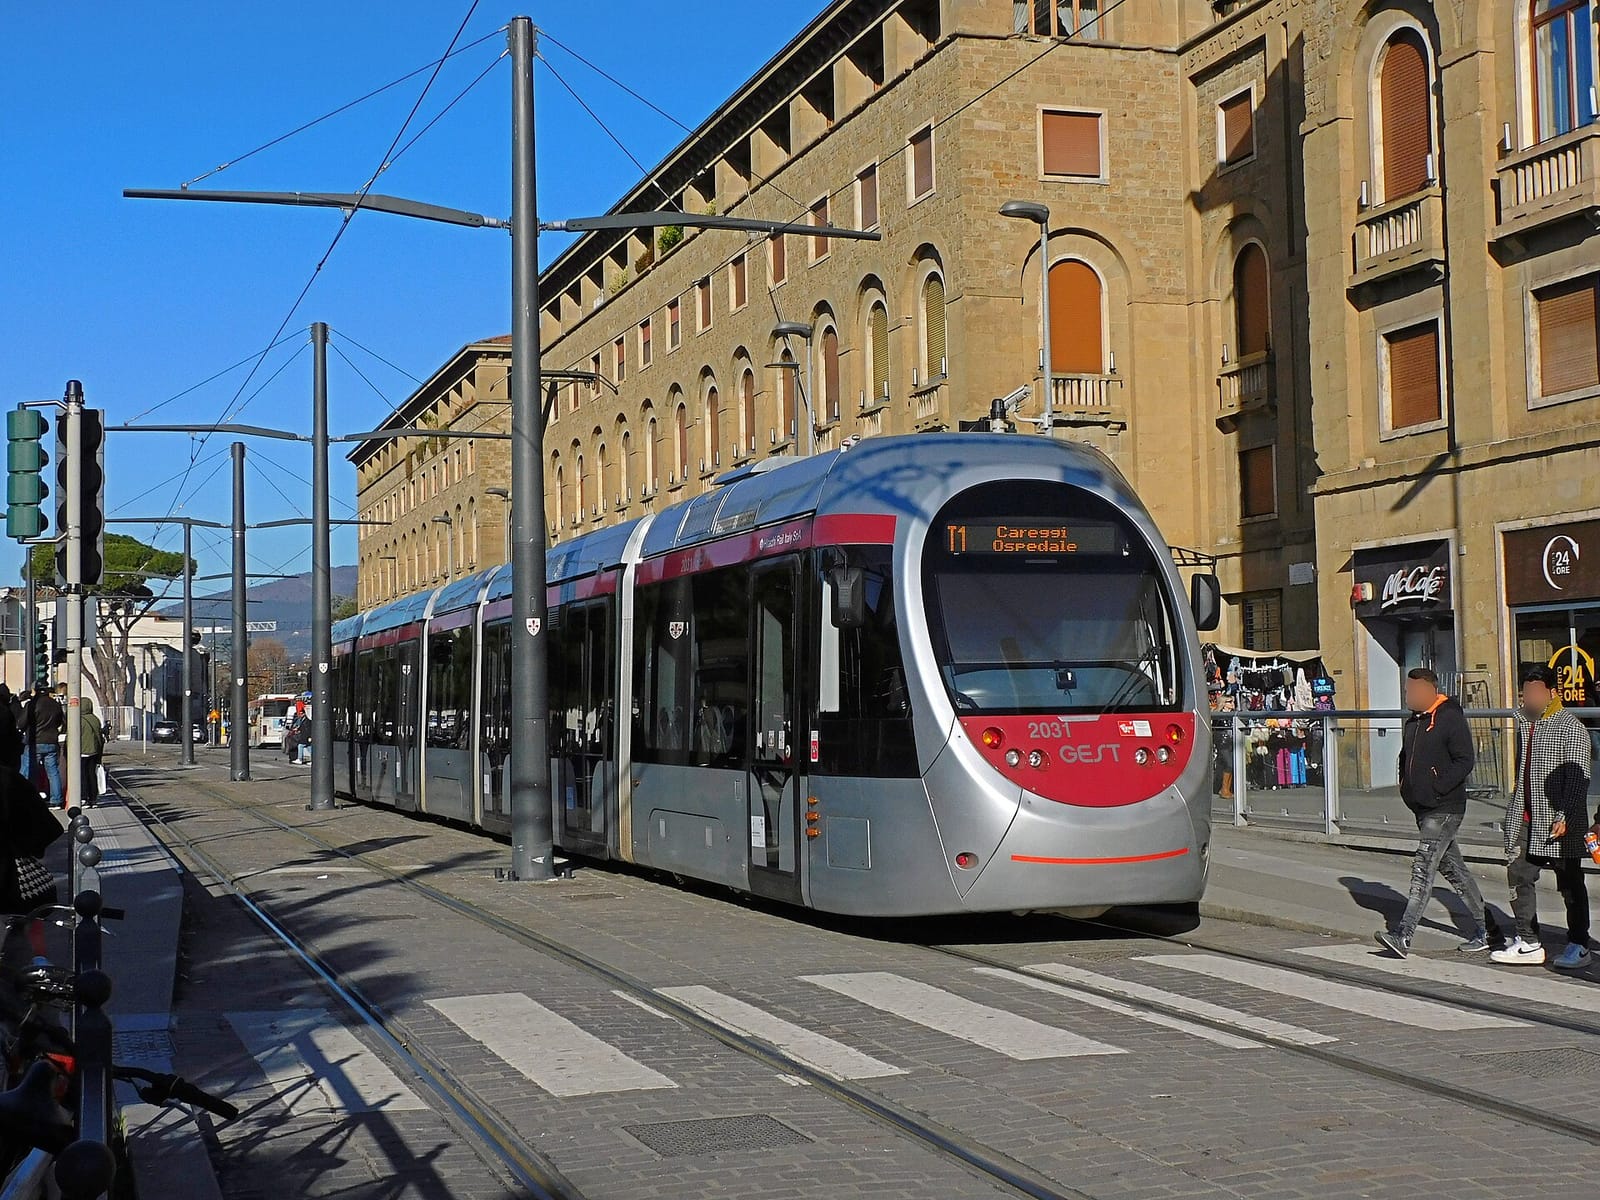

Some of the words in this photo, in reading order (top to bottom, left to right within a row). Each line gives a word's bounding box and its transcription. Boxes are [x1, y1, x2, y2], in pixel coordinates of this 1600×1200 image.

[947, 525, 967, 552] T1
[996, 526, 1068, 539] Careggi
[992, 540, 1078, 552] Ospedale
[1555, 551, 1570, 566] 24
[1555, 566, 1571, 575] ORE
[1562, 665, 1585, 688] 24
[1563, 689, 1586, 701] ORE
[1028, 721, 1072, 738] 2031
[1059, 743, 1121, 763] GEST
